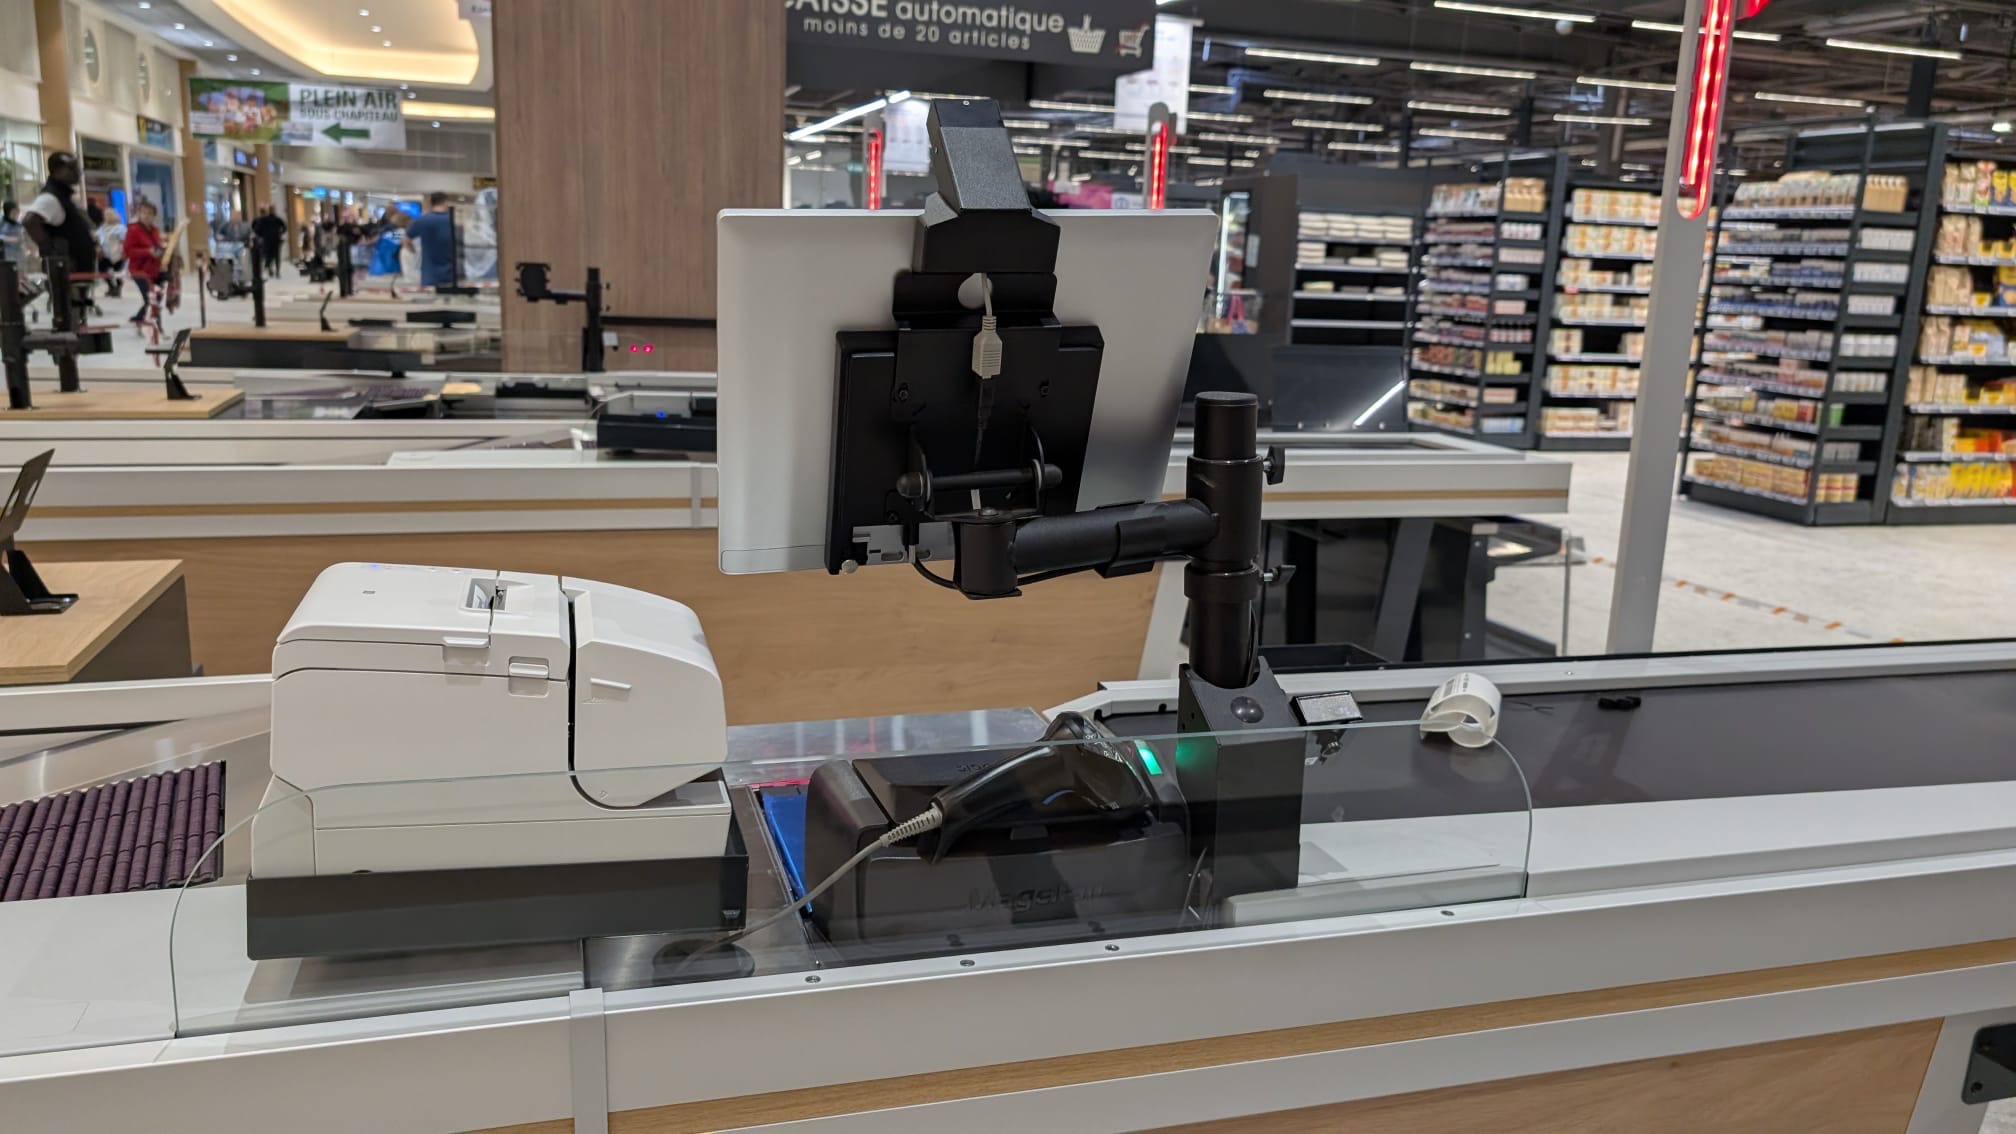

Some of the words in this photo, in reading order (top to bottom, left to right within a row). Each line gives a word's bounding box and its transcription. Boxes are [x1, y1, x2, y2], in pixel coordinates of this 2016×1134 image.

[784, 0, 888, 17] SSE
[895, 0, 1065, 34] automatique
[803, 17, 869, 37] moins
[877, 22, 906, 40] de
[915, 24, 940, 43] 20
[948, 28, 1031, 51] articles
[299, 88, 357, 108] PLEIN
[364, 90, 397, 110] AIR
